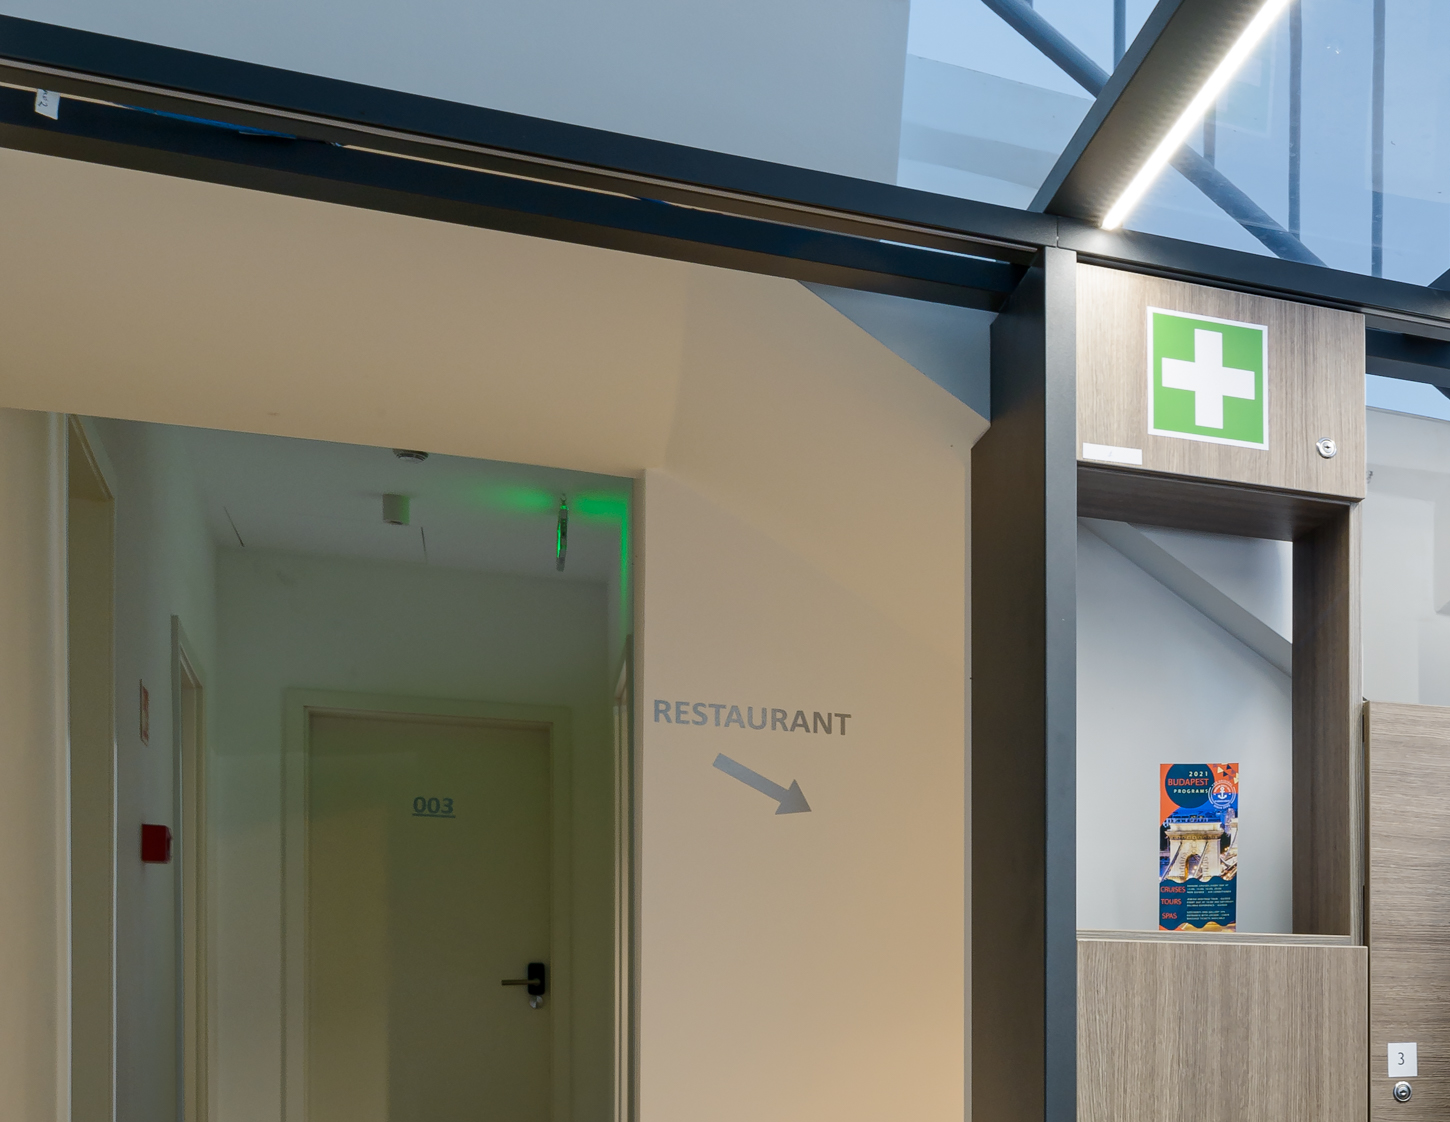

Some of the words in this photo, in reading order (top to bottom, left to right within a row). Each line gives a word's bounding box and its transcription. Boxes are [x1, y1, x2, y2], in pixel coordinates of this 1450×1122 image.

[653, 699, 852, 736] RESTAURANT
[1167, 778, 1209, 786] BUDAPEST
[413, 796, 454, 814] 003
[1397, 1051, 1405, 1066] 3
